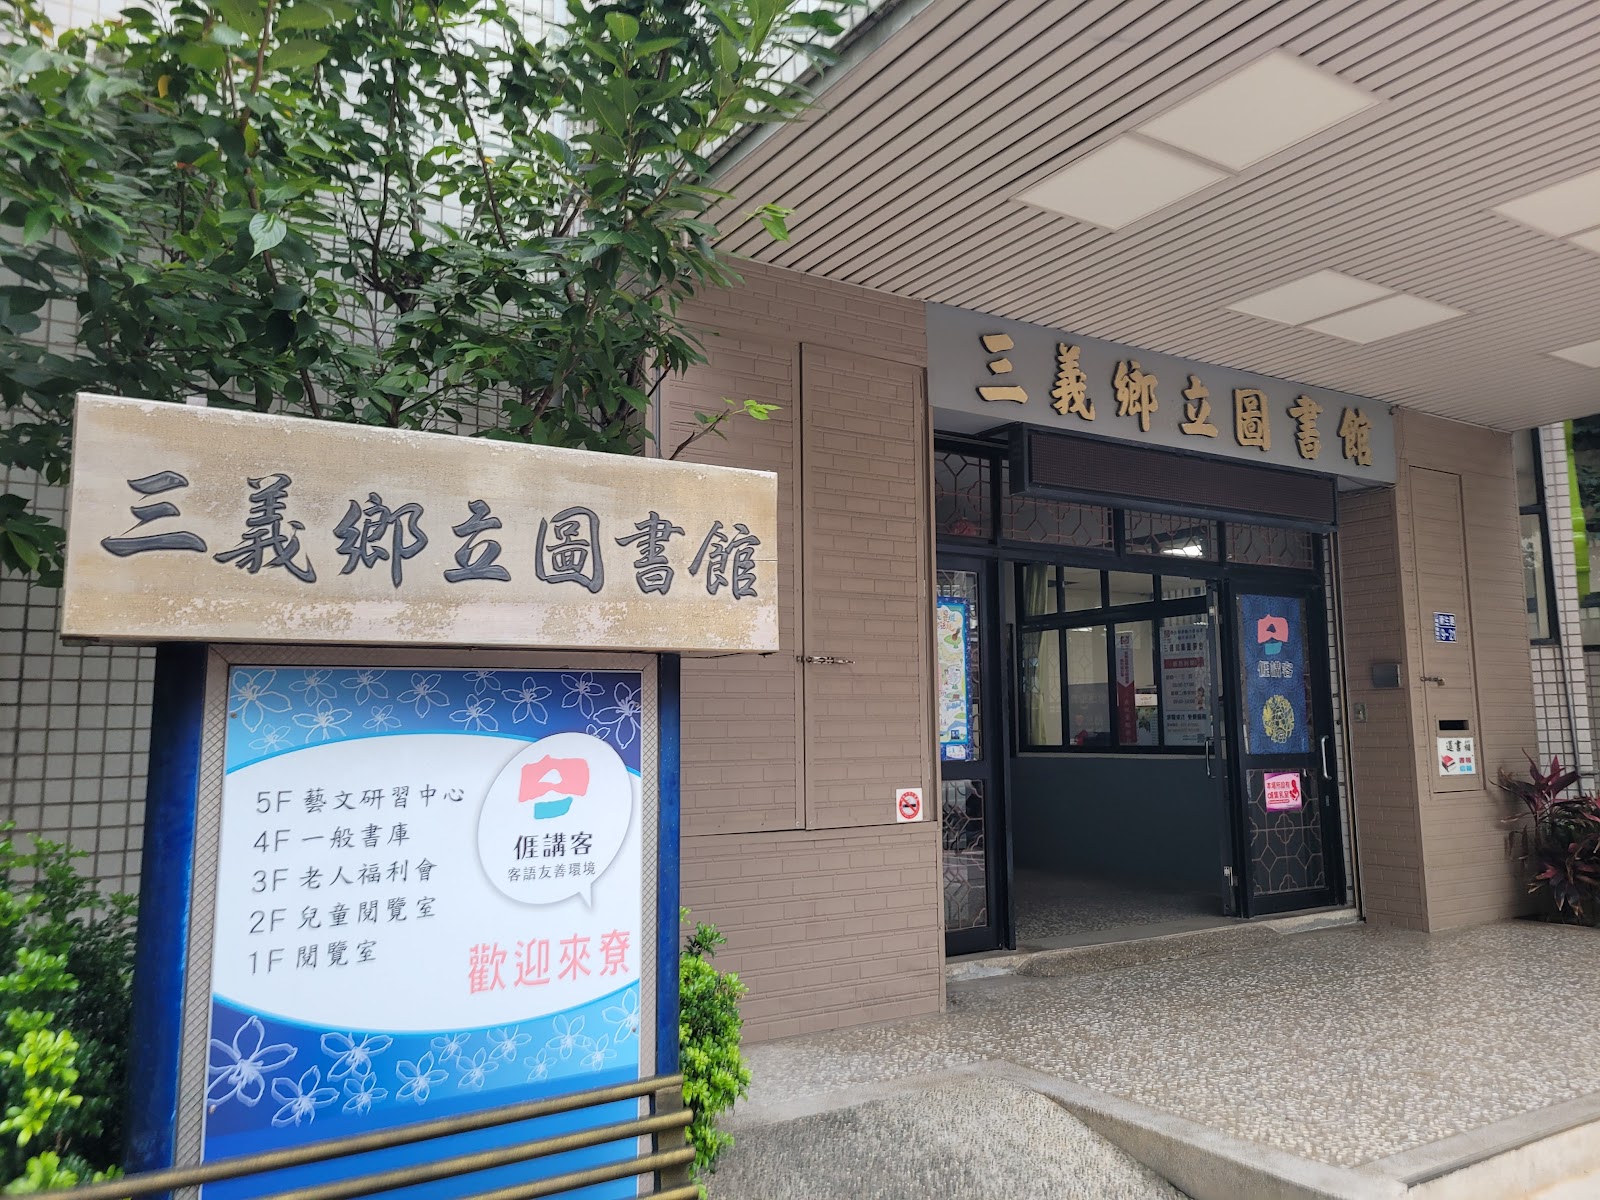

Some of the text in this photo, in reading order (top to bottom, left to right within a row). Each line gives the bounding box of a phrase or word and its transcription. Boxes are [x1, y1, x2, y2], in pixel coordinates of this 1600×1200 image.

[977, 333, 1373, 466] 三義鄉立圖書館
[101, 470, 762, 600] 三義鄉立圖書館
[256, 783, 465, 814] 5F 藝文研習中心
[253, 821, 411, 853] 4F 一般書庫
[252, 857, 438, 893] 3F 老人福利會
[508, 860, 596, 882] 客語友善環境
[249, 896, 437, 934] 2F 兒童閱覽室
[249, 939, 377, 975] 1F 閱覽室
